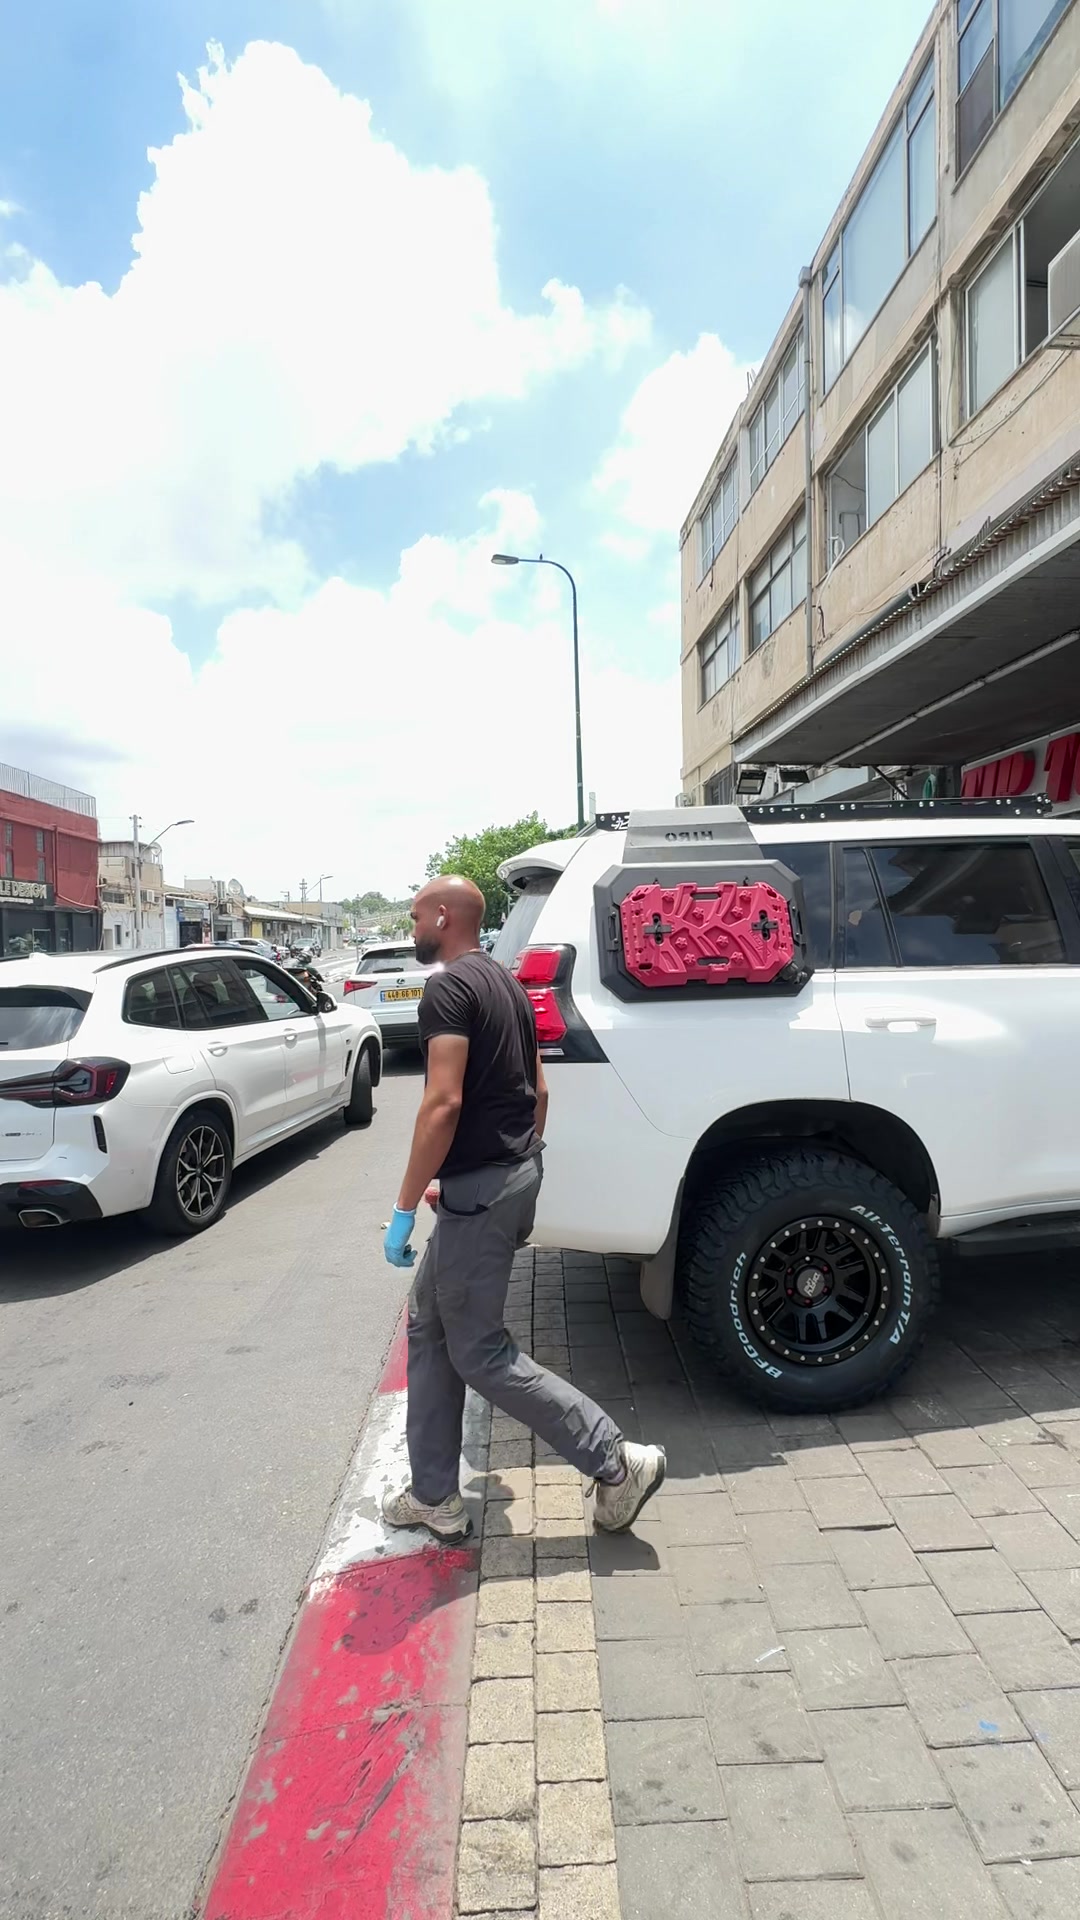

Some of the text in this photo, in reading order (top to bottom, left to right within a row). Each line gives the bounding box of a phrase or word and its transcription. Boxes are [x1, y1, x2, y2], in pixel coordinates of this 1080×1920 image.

[11, 880, 47, 899] DESIGN
[729, 1252, 783, 1379] BFGoodrich
[850, 1204, 914, 1345] All-Terrain T/A
